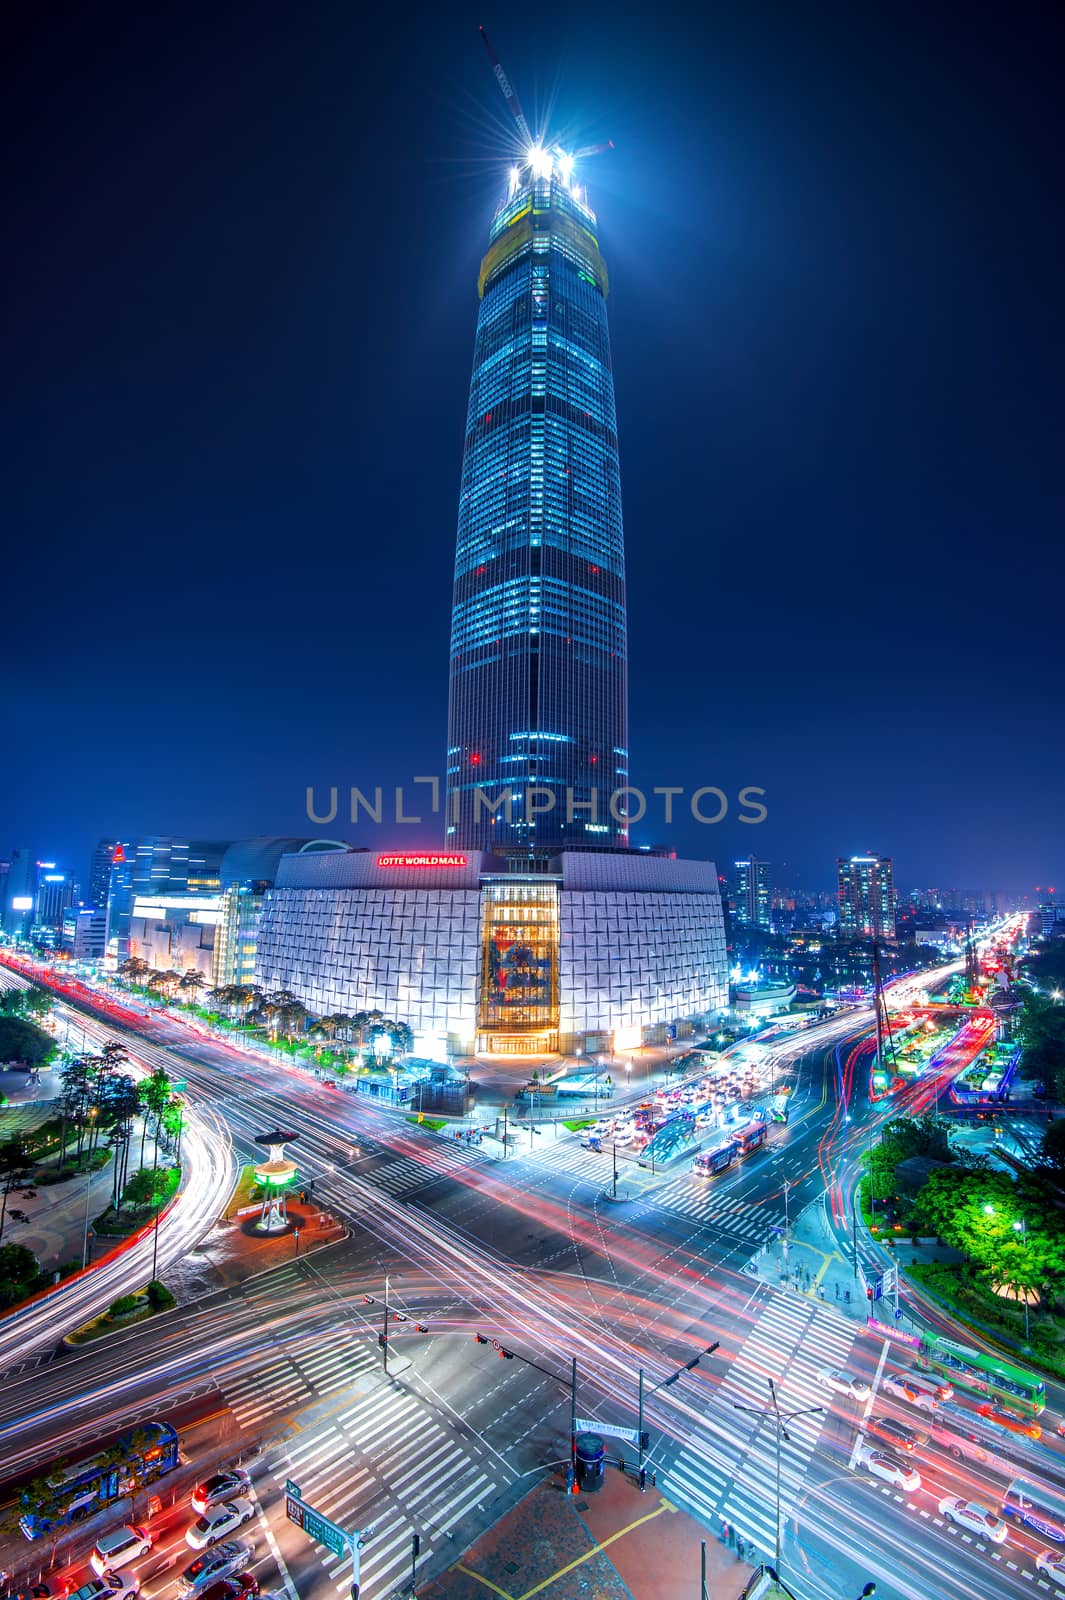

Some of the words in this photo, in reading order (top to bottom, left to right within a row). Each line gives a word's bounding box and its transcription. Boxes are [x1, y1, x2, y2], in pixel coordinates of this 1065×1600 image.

[379, 857, 405, 865] LOTTE
[405, 857, 438, 865] WORLD
[439, 857, 466, 865] MALL
